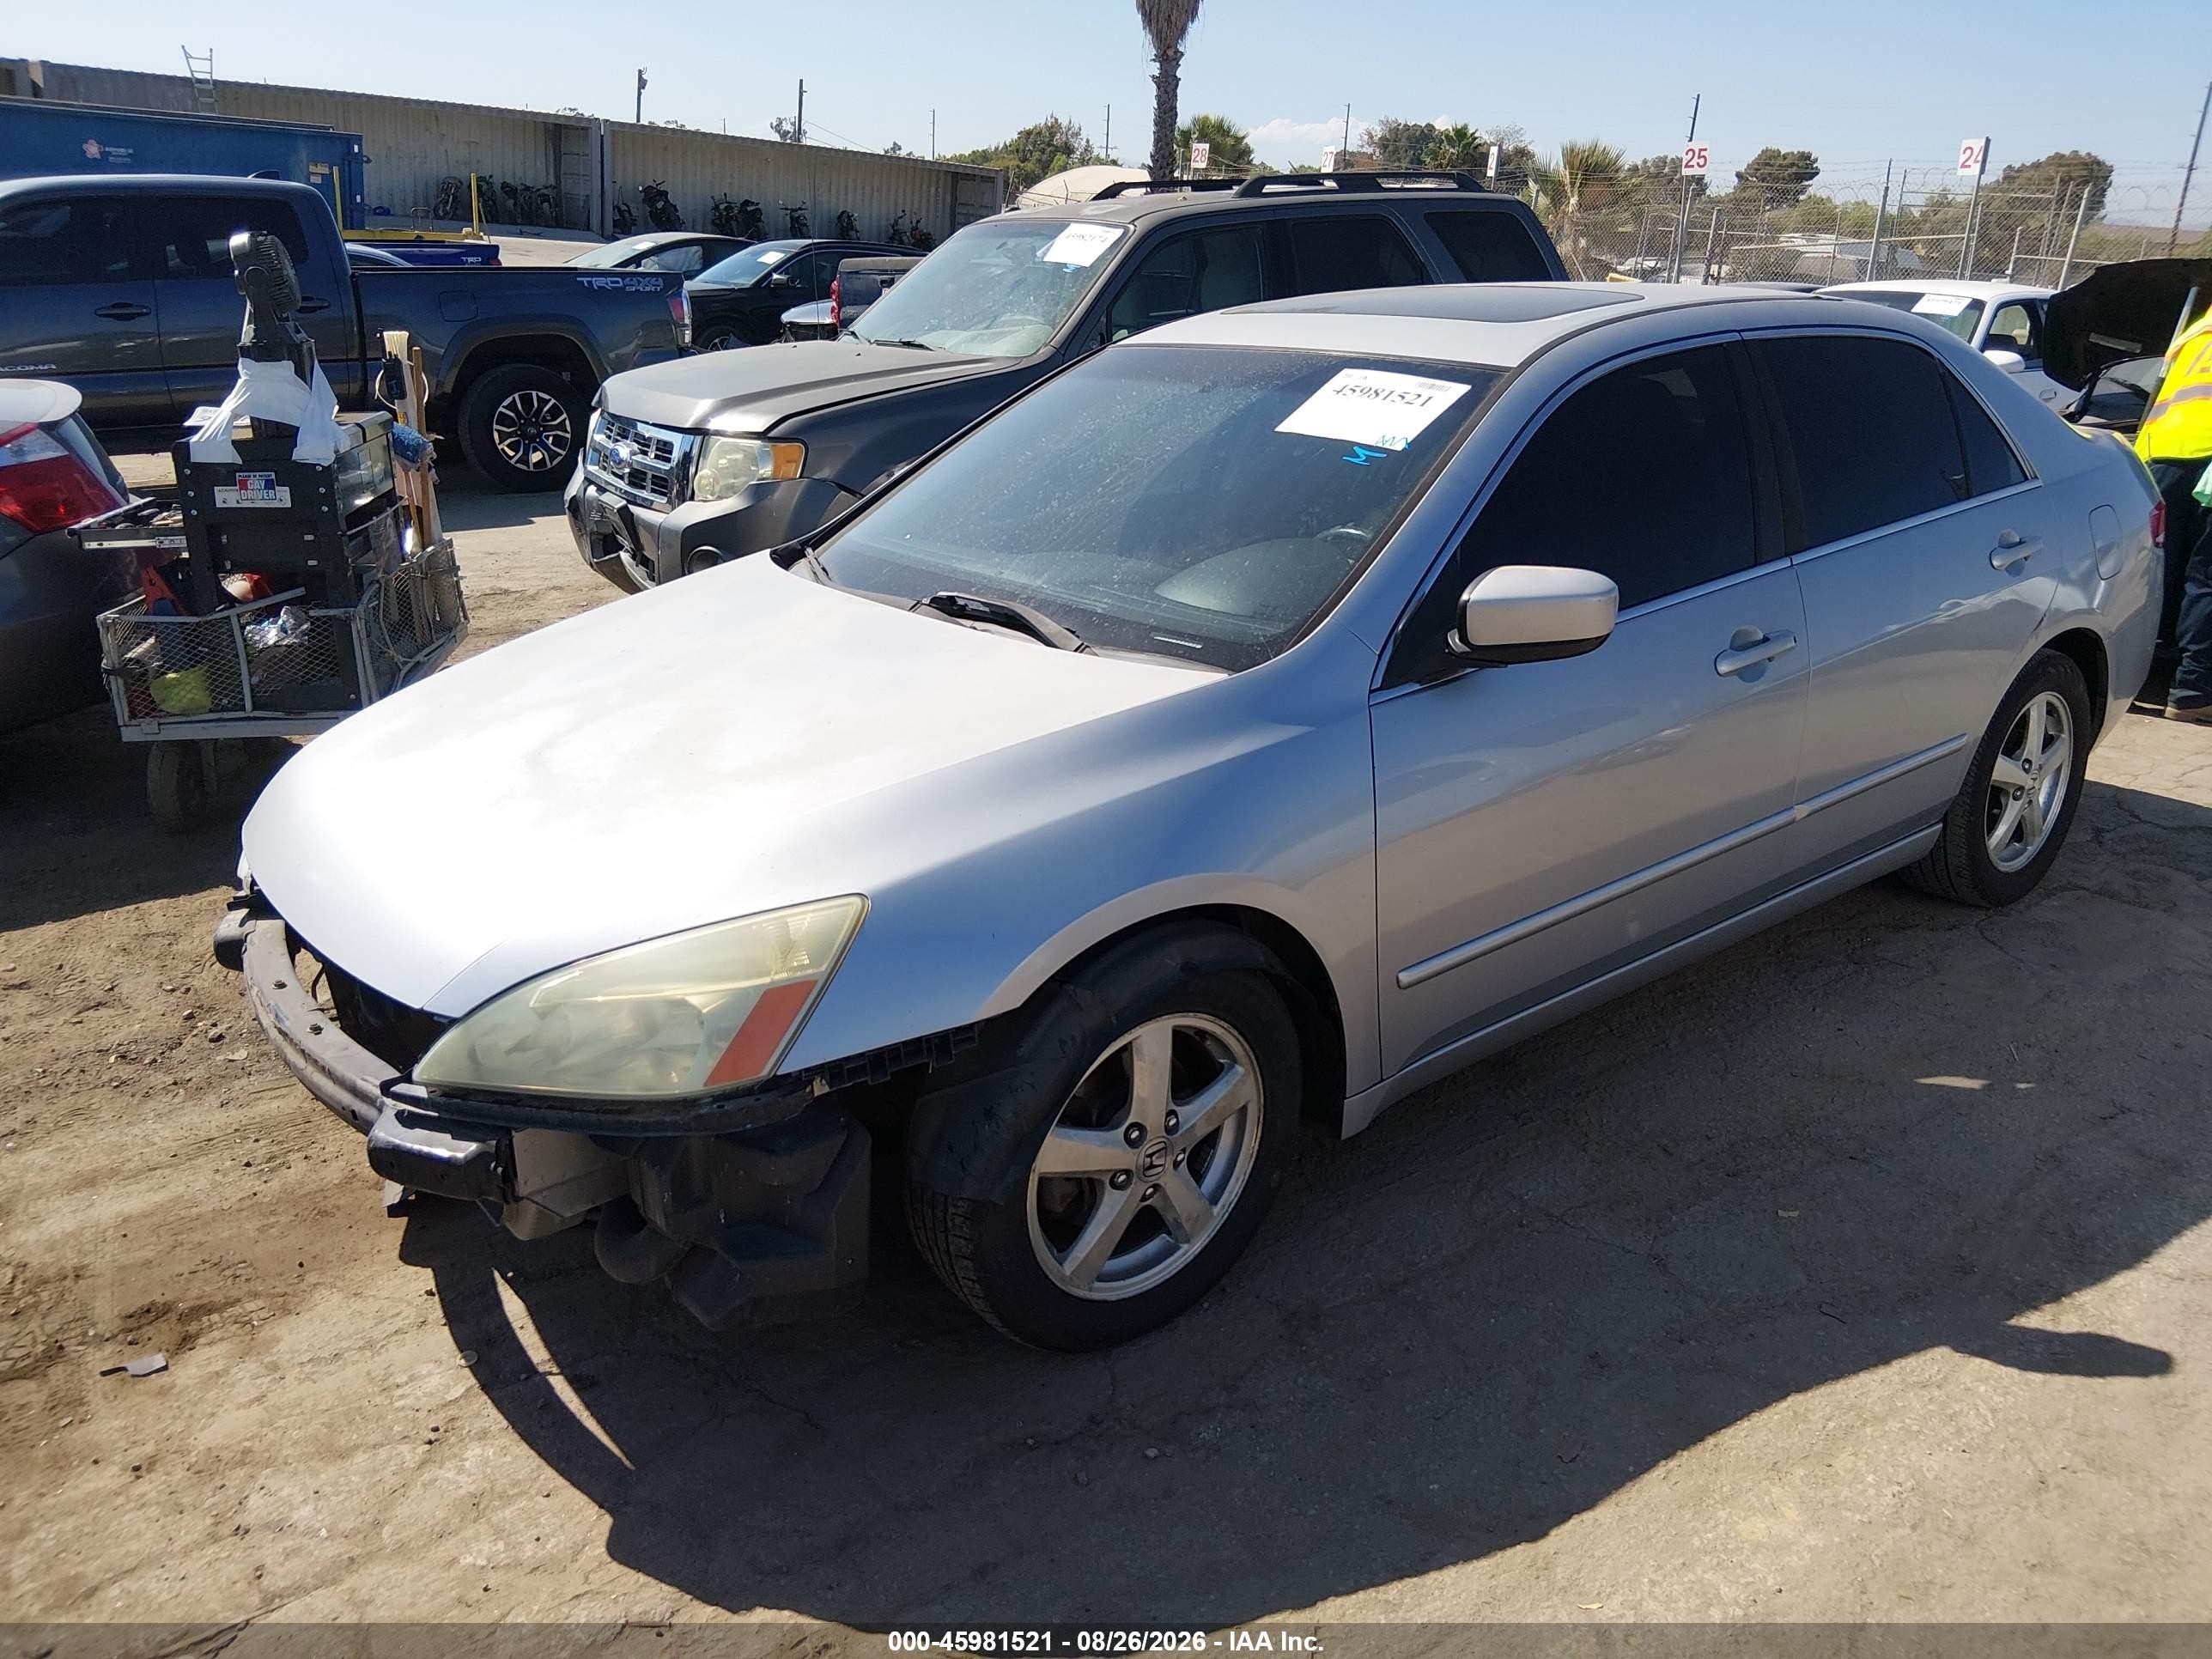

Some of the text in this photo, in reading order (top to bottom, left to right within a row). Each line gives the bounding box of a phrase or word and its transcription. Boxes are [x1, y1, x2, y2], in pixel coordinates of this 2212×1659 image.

[1193, 149, 1207, 163] 28
[1322, 151, 1334, 168] 27
[1684, 148, 1708, 168] 25
[576, 276, 623, 290] TRD
[1333, 384, 1434, 407] 45981521
[240, 489, 276, 500] DRIVER
